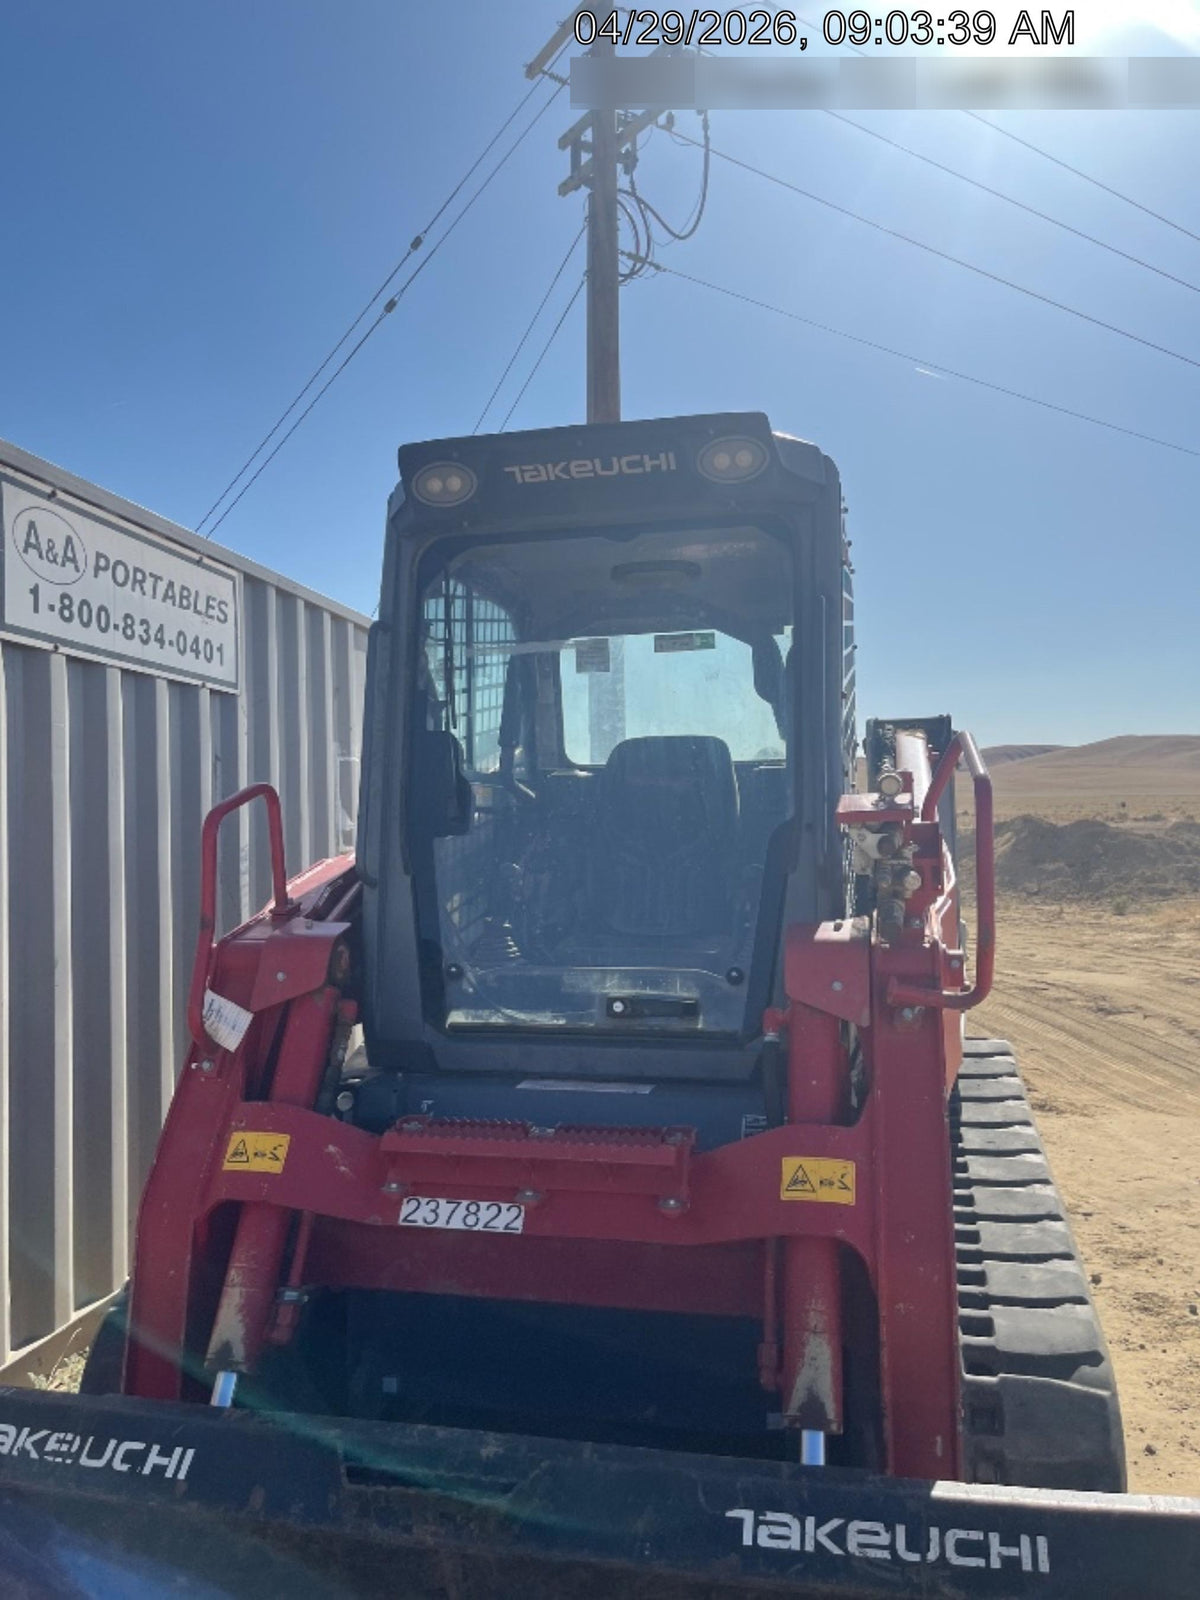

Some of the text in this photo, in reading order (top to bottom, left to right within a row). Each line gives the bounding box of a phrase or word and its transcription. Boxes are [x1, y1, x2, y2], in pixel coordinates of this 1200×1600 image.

[22, 519, 229, 624] A&A PORTABLES
[28, 582, 225, 667] 1-800-834-0401
[401, 1197, 524, 1232] 237822
